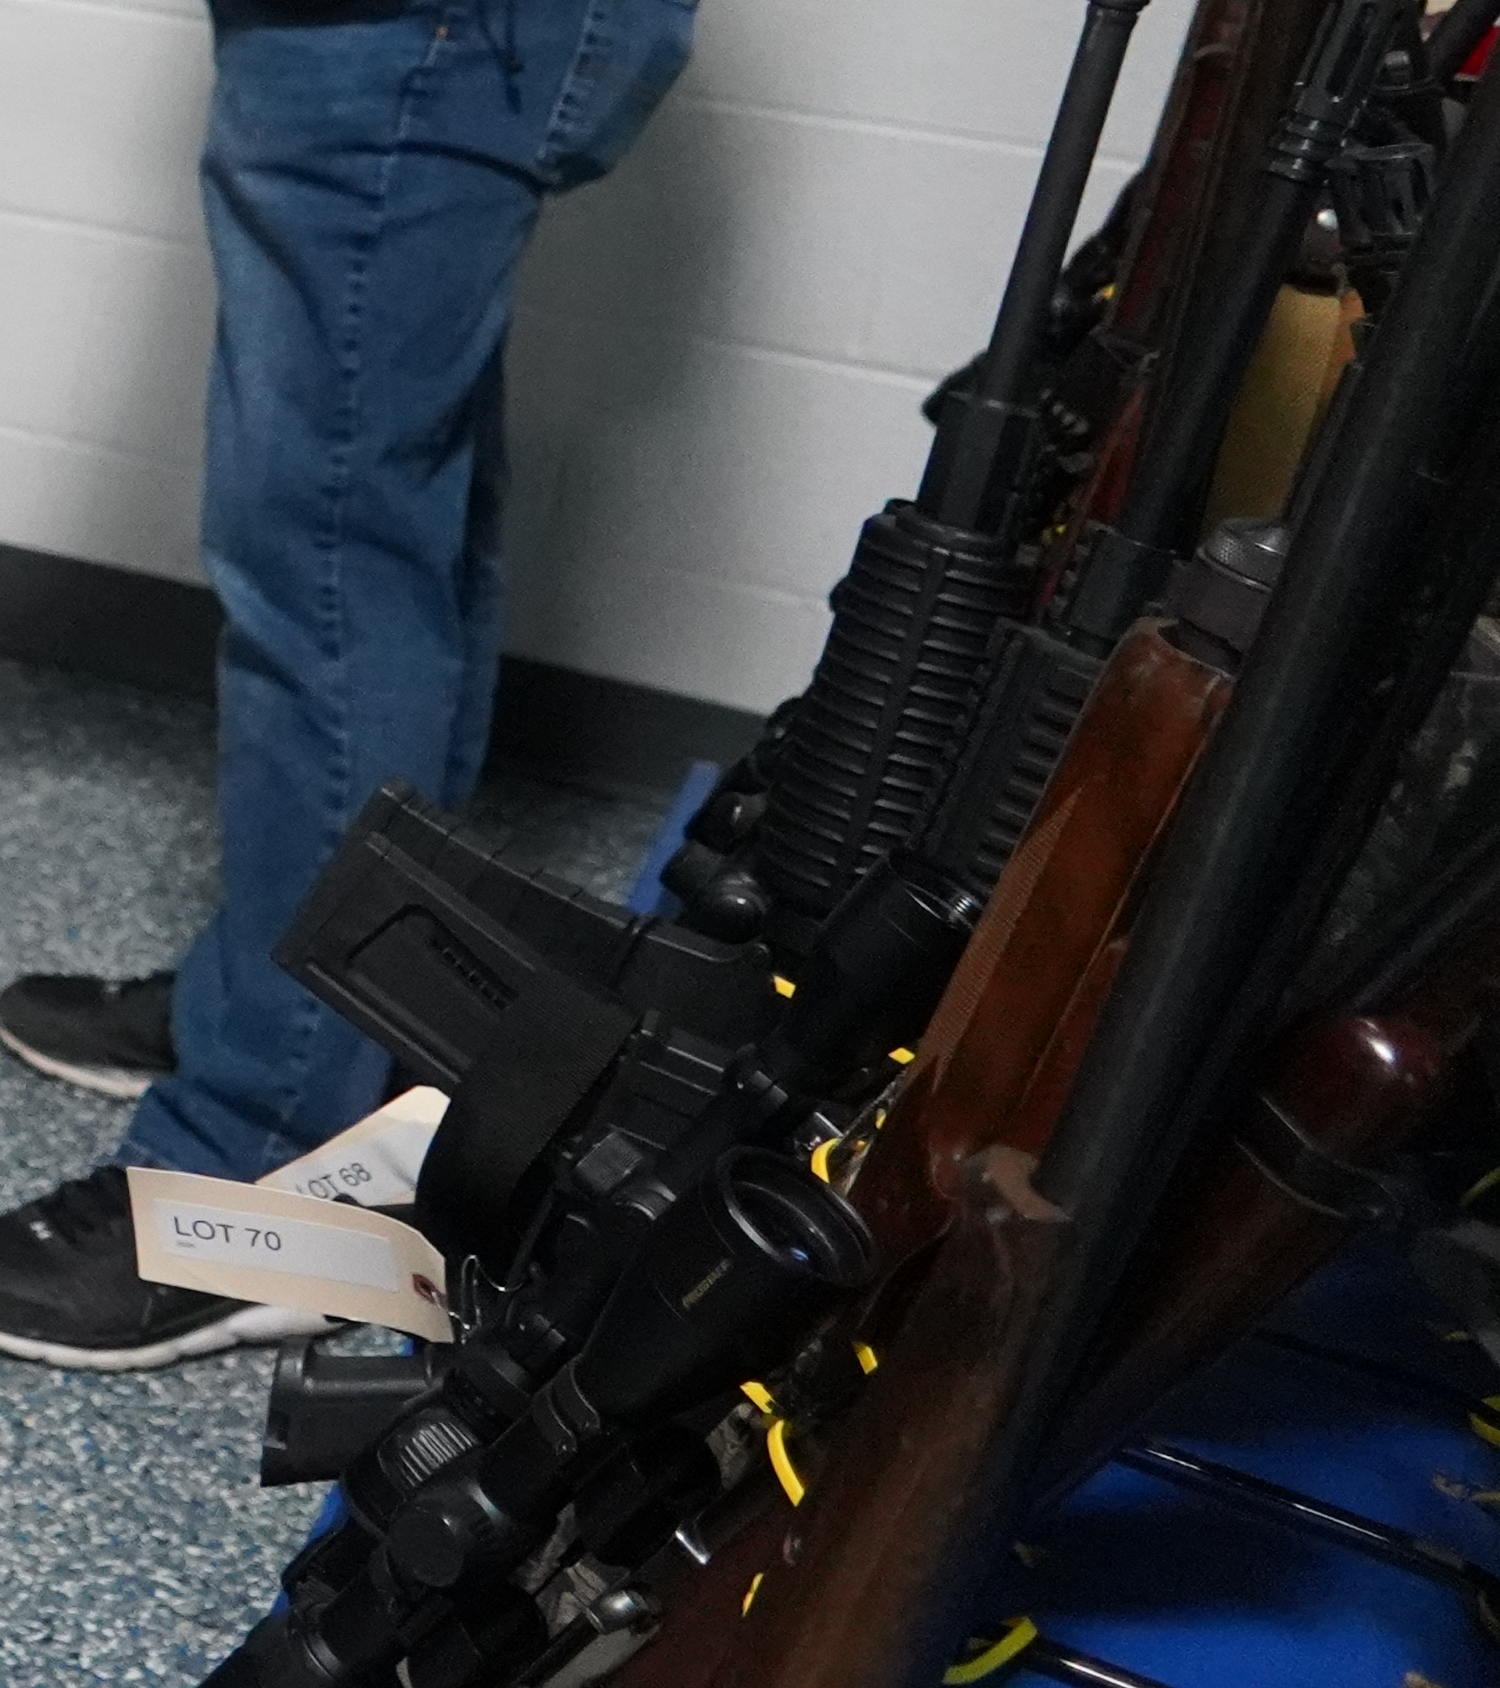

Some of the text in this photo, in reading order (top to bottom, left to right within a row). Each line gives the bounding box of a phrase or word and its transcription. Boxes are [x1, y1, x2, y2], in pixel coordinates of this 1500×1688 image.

[339, 1163, 372, 1187] 68
[174, 1216, 282, 1251] LOT 70
